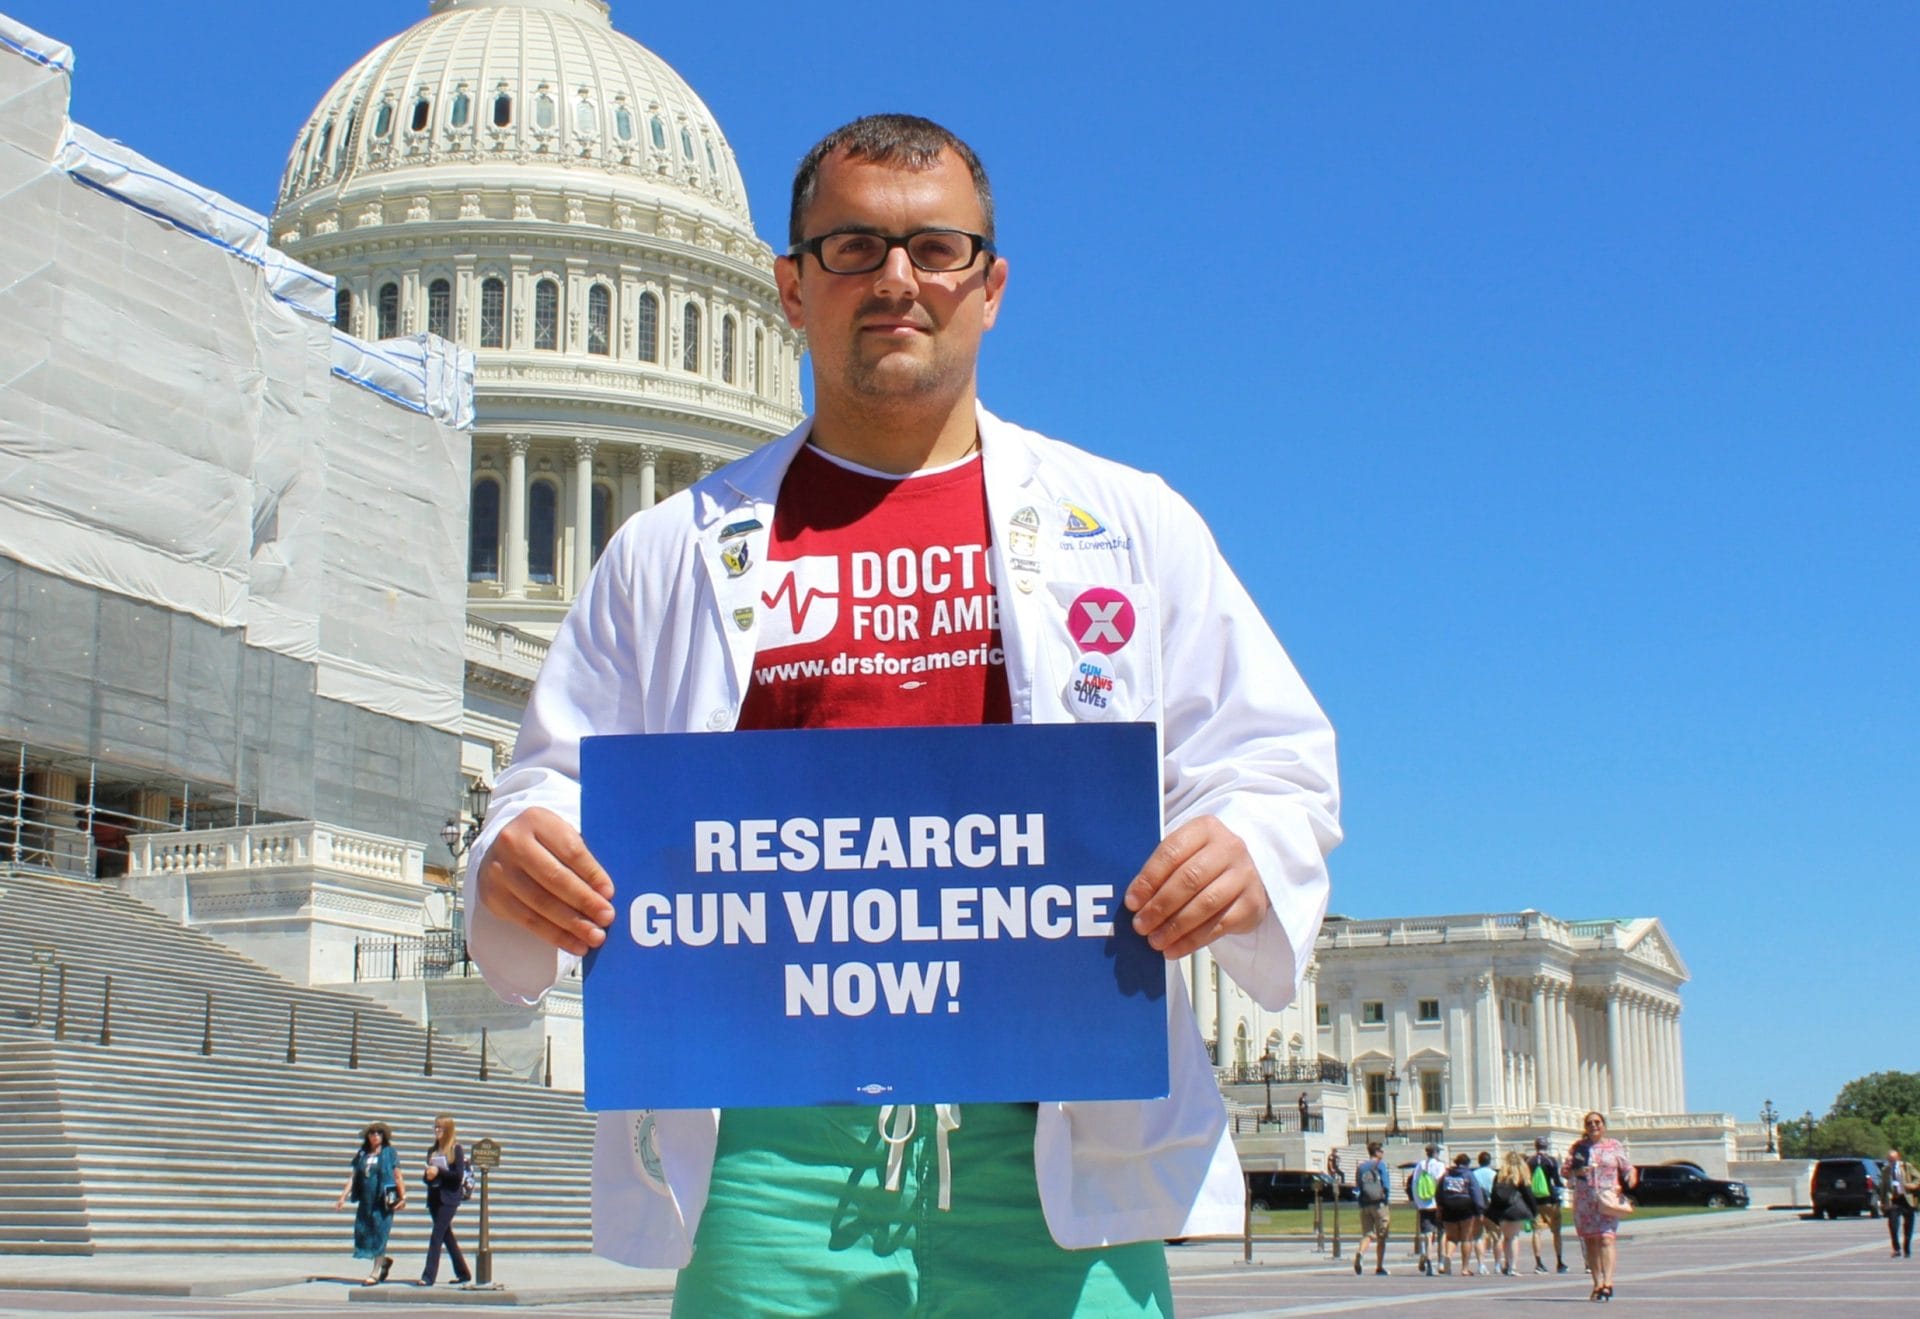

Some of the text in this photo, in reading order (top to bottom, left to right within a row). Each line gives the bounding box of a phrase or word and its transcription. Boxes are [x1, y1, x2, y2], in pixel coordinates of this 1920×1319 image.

[853, 604, 919, 641] FOR
[1079, 601, 1126, 644] X
[1079, 662, 1102, 676] GUN
[1084, 672, 1113, 692] LAWS
[1073, 680, 1101, 698] SAVE
[1078, 689, 1107, 709] LIVES
[694, 813, 1045, 873] RESEARCH
[629, 884, 1115, 948] GUN VIOLENCE
[784, 961, 960, 1017] NOW!
